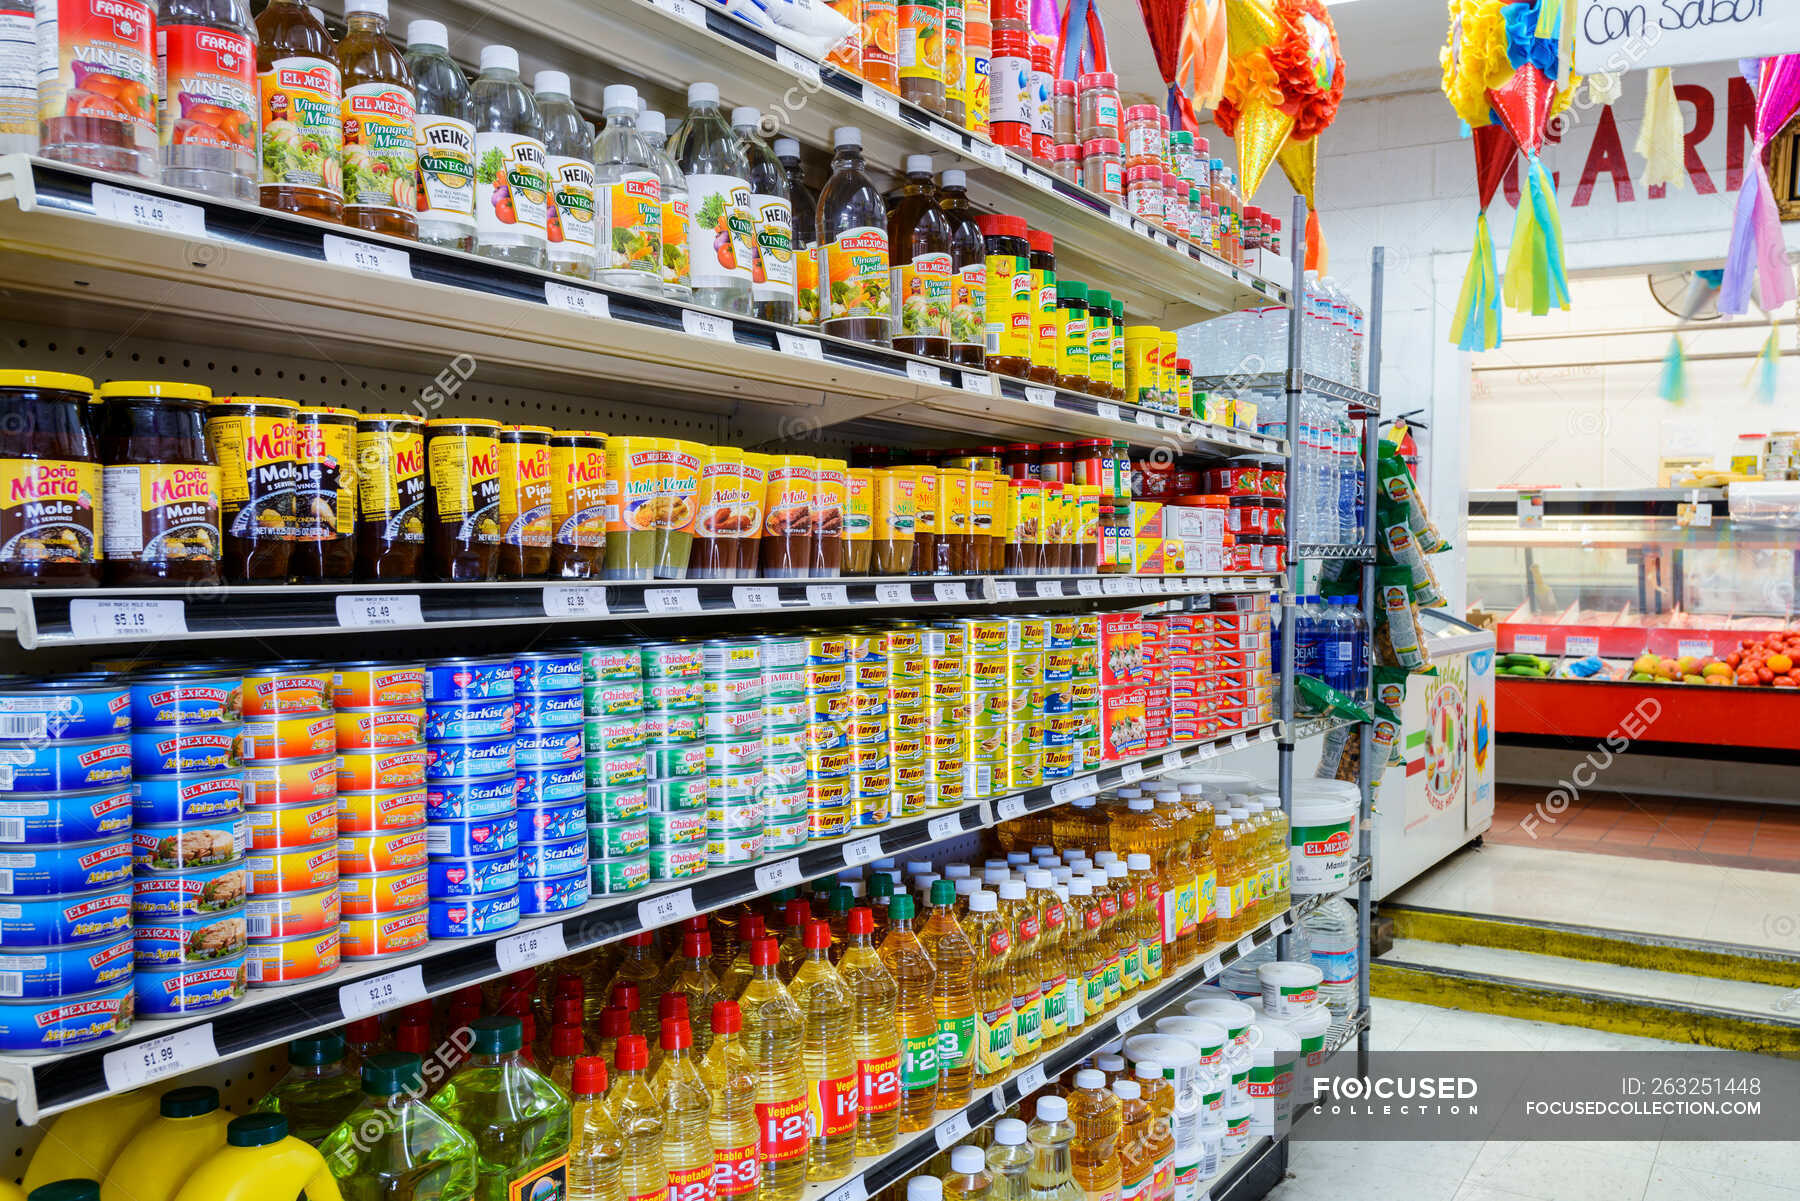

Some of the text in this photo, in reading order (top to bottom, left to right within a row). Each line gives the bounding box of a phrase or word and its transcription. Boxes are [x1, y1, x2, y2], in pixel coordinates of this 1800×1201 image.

[200, 34, 250, 58] FARAON
[283, 72, 301, 84] EL
[354, 101, 372, 110] EL
[429, 128, 471, 152] HEINZ
[423, 158, 474, 178] VINEGAR
[133, 204, 164, 222] $1.49
[843, 238, 855, 249] EL
[355, 252, 379, 267] $1.79
[37, 464, 77, 481] Doña
[174, 467, 208, 482] Doña
[11, 477, 79, 502] María
[151, 478, 209, 504] María
[26, 501, 74, 518] Mole
[166, 502, 206, 519] Mole
[113, 612, 146, 627] $5.19
[151, 687, 227, 706] EL MEXICANO
[452, 707, 504, 721] StarKist
[160, 735, 232, 753] EL MEXICANO
[515, 736, 566, 750] StarKist
[83, 752, 98, 764] EL
[462, 745, 510, 760] StarKist
[183, 779, 241, 799] EL MEXICAN
[1306, 844, 1322, 855] EL
[68, 908, 85, 919] EL
[167, 968, 238, 992] EL MEXICANO
[369, 983, 393, 1000] $2.19
[39, 1000, 120, 1025] EL MEXICANO
[1045, 995, 1067, 1020] Mazo
[944, 1021, 956, 1031] Oil
[1016, 1011, 1041, 1037] Mazo
[907, 1039, 926, 1051] Pure
[989, 1024, 1012, 1052] Mazo
[143, 1047, 174, 1067] $1.99
[715, 1151, 743, 1162] etable
